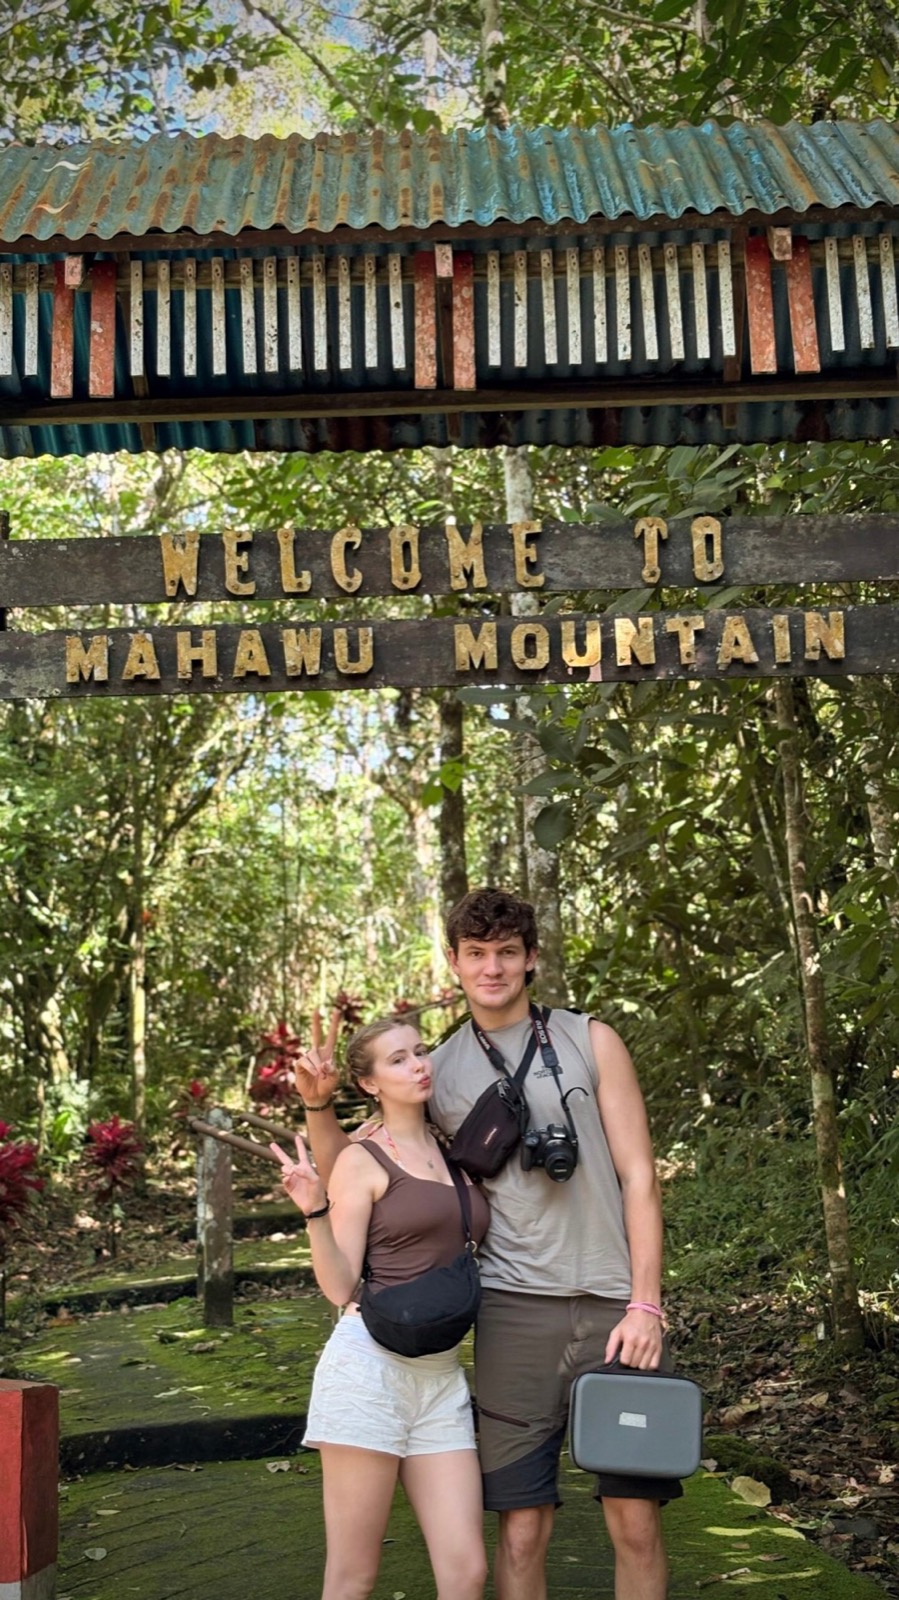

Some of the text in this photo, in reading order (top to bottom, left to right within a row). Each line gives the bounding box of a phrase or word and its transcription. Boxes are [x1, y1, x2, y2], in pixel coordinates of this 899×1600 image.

[160, 515, 725, 597] WELCOME TO
[65, 610, 846, 684] MAHAWU MOUNTAIN
